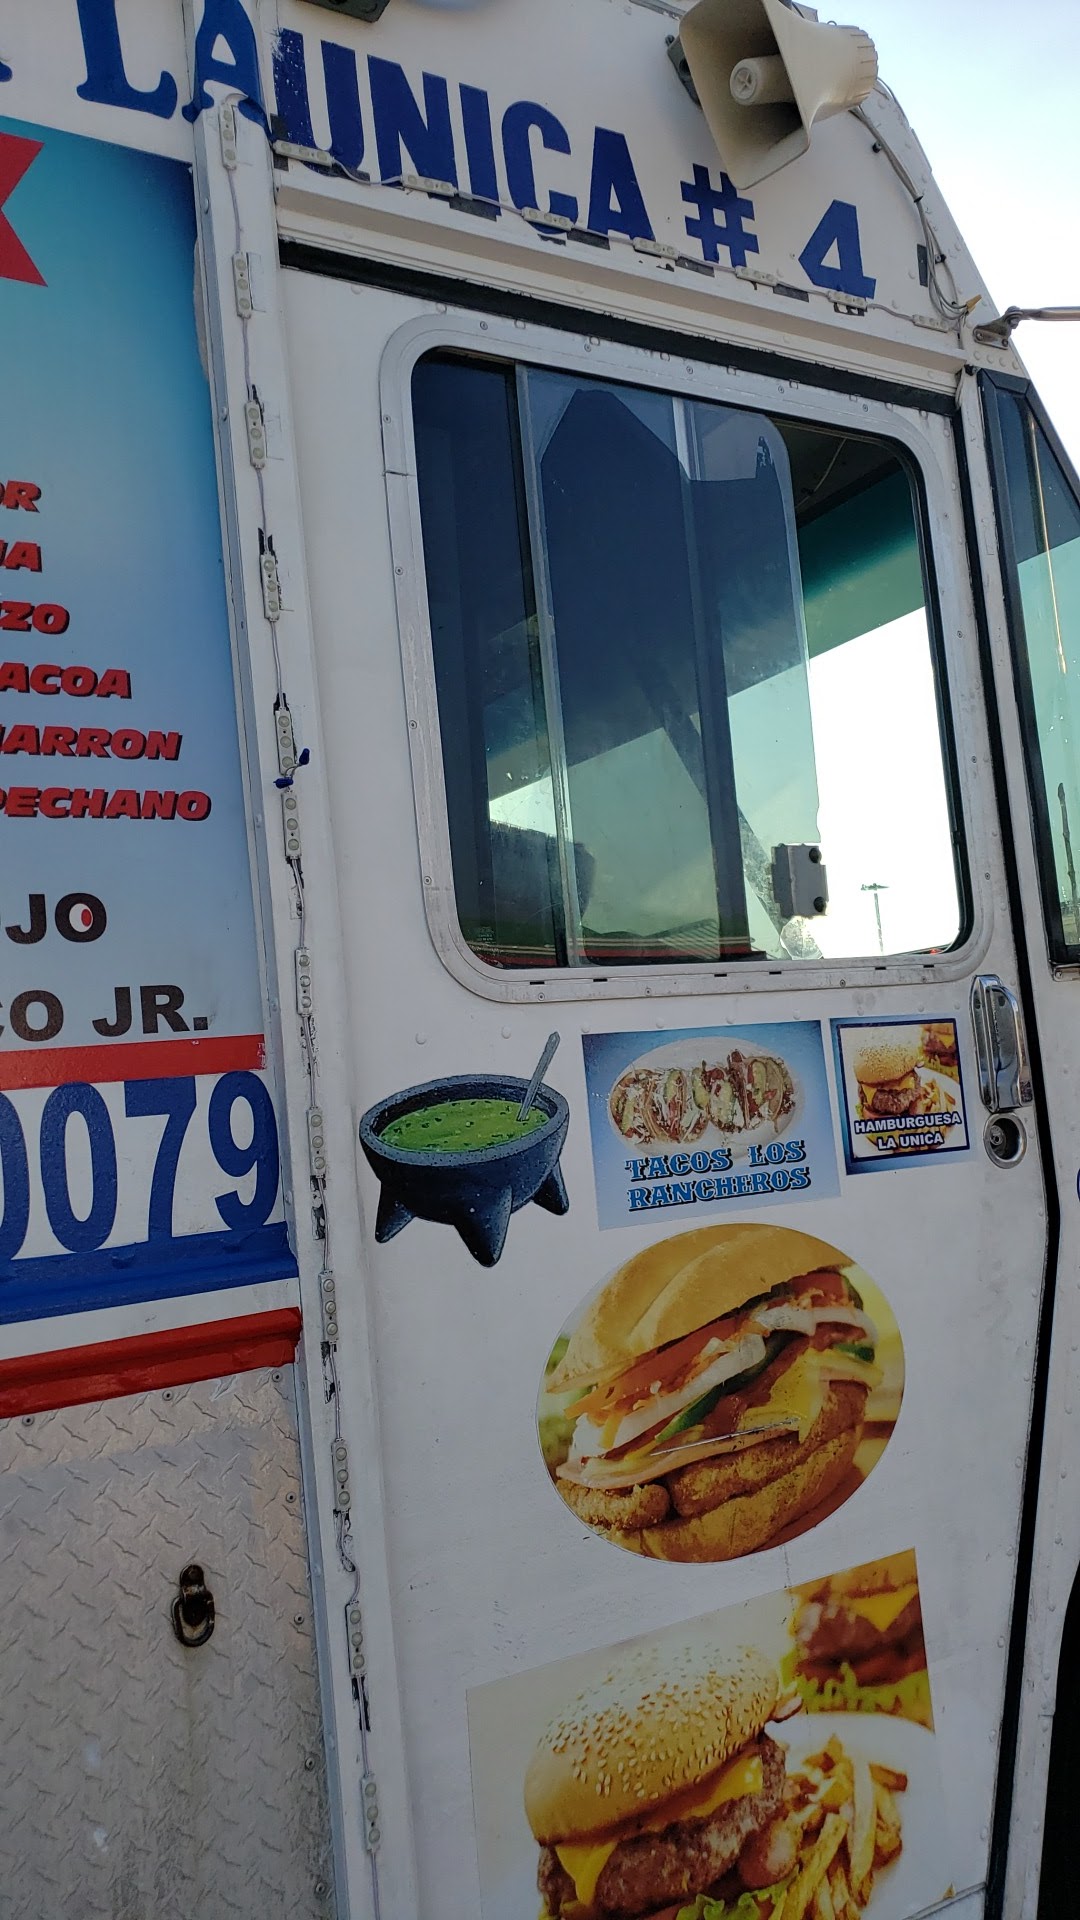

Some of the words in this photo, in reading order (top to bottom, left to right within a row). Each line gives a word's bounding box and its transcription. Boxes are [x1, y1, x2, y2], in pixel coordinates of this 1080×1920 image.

[76, 0, 277, 143] LA
[271, 28, 656, 242] UNICA
[798, 199, 877, 299] 4
[0, 480, 42, 513] R
[0, 540, 42, 573] A
[0, 662, 132, 698] ACOA
[0, 724, 182, 761] ARRON
[0, 786, 211, 821] ECHANO
[0, 989, 64, 1042] O
[91, 984, 209, 1037] JR.
[854, 1111, 962, 1134] HAMBURGUESA
[877, 1135, 898, 1151] LA
[899, 1131, 945, 1148] UNICA
[625, 1148, 733, 1182] TACOS
[747, 1139, 806, 1167] LOS
[627, 1167, 811, 1212] RANCHEROS
